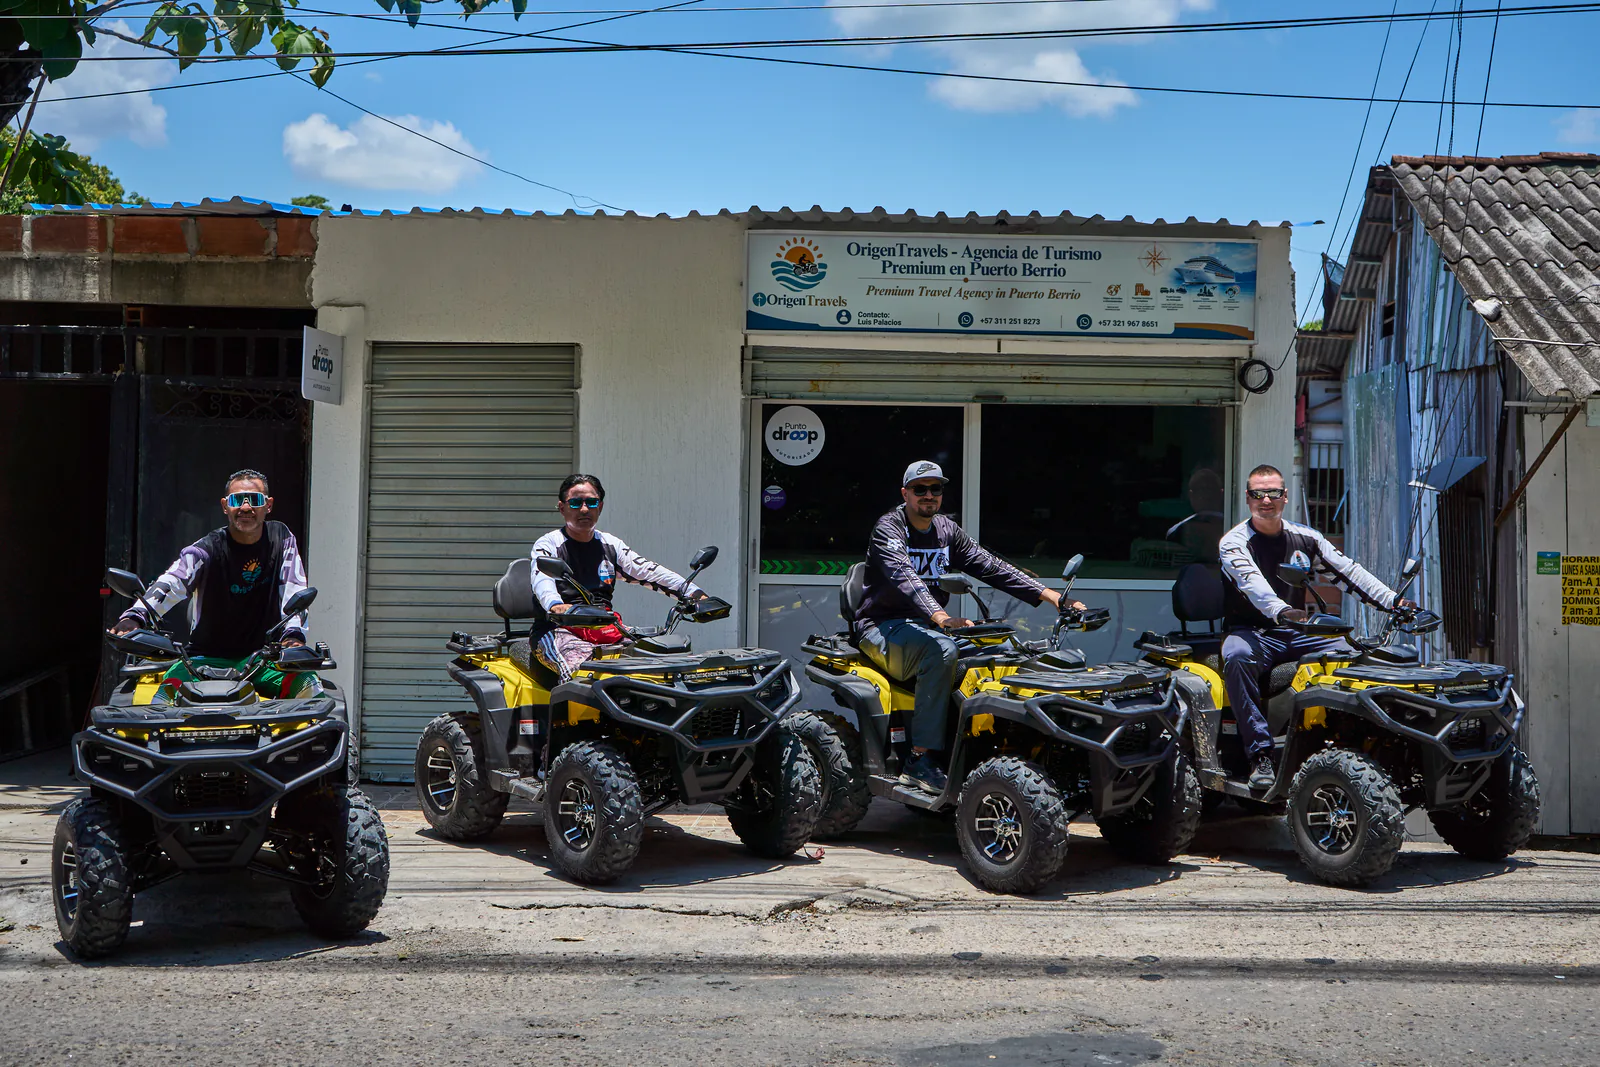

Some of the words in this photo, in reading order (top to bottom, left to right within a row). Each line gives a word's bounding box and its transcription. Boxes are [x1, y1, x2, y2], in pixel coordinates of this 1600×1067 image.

[846, 242, 948, 260] OrigenTravels
[961, 244, 1018, 261] Agencia
[1021, 246, 1039, 260] de
[1042, 246, 1102, 261] Turismo
[881, 260, 946, 275] Premium
[949, 265, 966, 275] en
[970, 262, 1018, 276] Puerto
[1021, 263, 1067, 277] Berrio
[866, 285, 915, 297] Premium
[918, 286, 953, 297] Travel
[954, 287, 993, 300] Agency
[995, 288, 1006, 299] in
[1008, 288, 1045, 299] Puerto
[1047, 289, 1081, 300] Berrio
[766, 293, 848, 308] OrigenTravels
[980, 317, 993, 325] +57
[994, 317, 1007, 325] 311
[1098, 319, 1111, 327] +57
[1141, 320, 1158, 328] 8651
[312, 349, 333, 379] droop
[784, 422, 807, 430] Punto
[772, 427, 818, 444] droop
[776, 448, 815, 459] AUTORIZADO
[1561, 565, 1578, 575] LUNES
[1580, 565, 1583, 575] A
[1561, 577, 1593, 587] 7am-A
[1561, 587, 1567, 595] Y
[1569, 587, 1575, 595] 2
[1577, 588, 1591, 596] pm
[1593, 587, 1600, 595] A
[1561, 605, 1567, 615] 7
[1569, 607, 1593, 615] am-a
